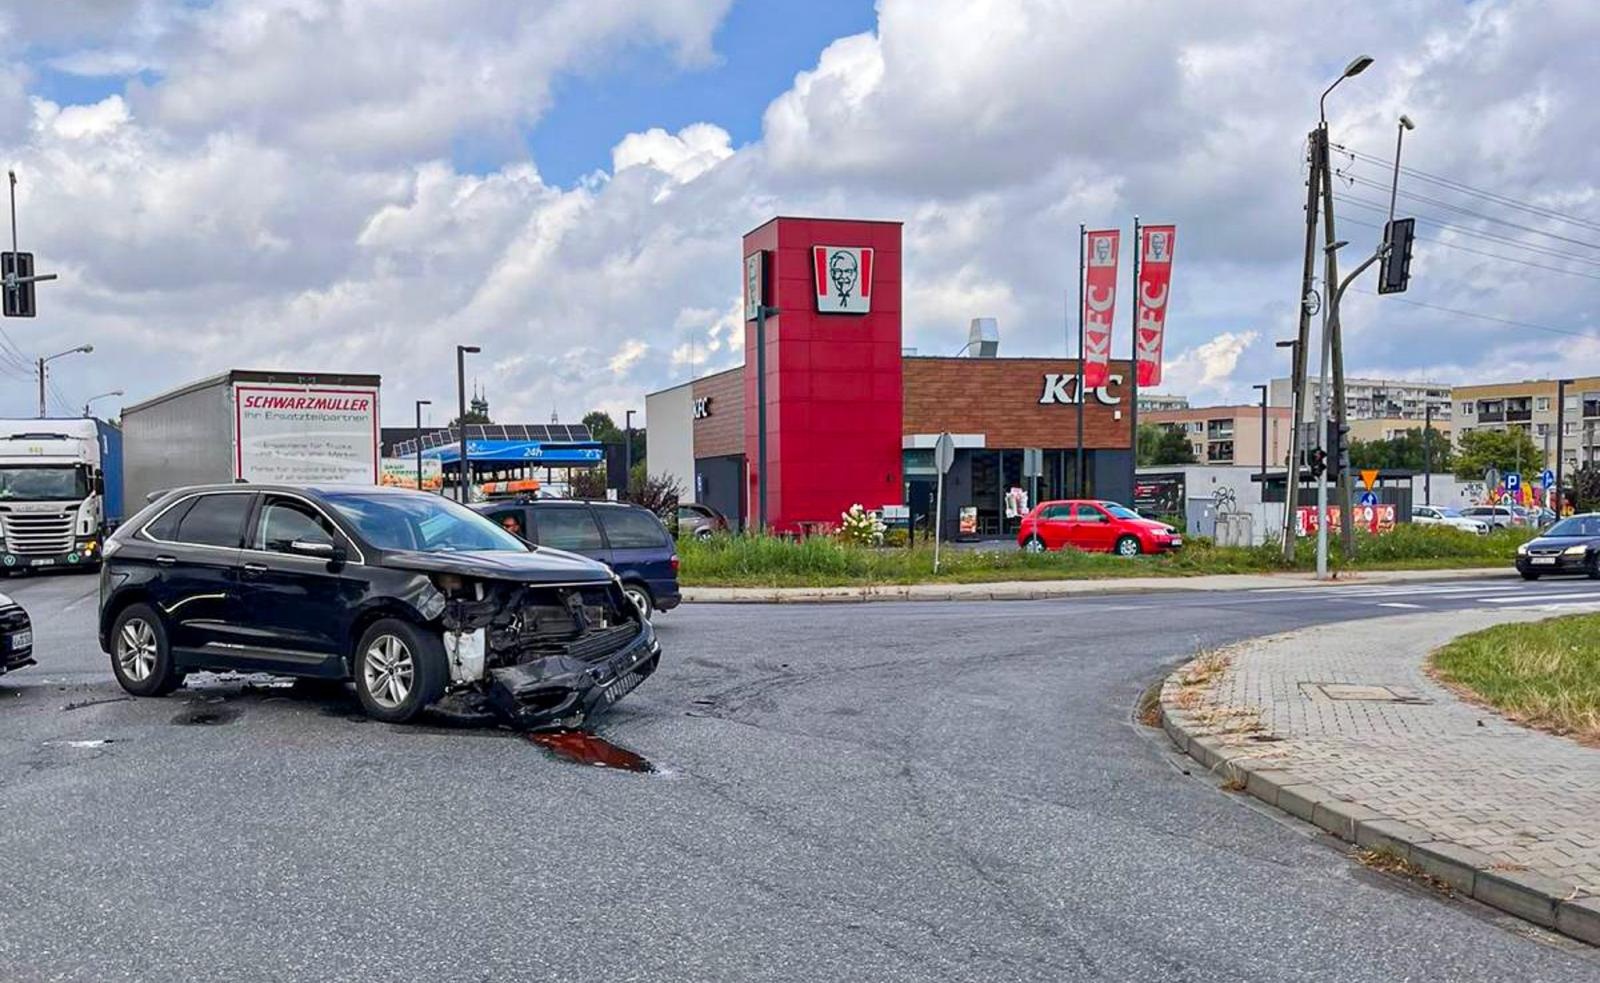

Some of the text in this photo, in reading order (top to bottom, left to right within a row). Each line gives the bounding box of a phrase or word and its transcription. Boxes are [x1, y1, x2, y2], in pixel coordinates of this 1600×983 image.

[1086, 285, 1114, 366] KFC
[1138, 281, 1168, 366] KFC
[523, 447, 543, 457] 24h
[1508, 475, 1517, 489] P
